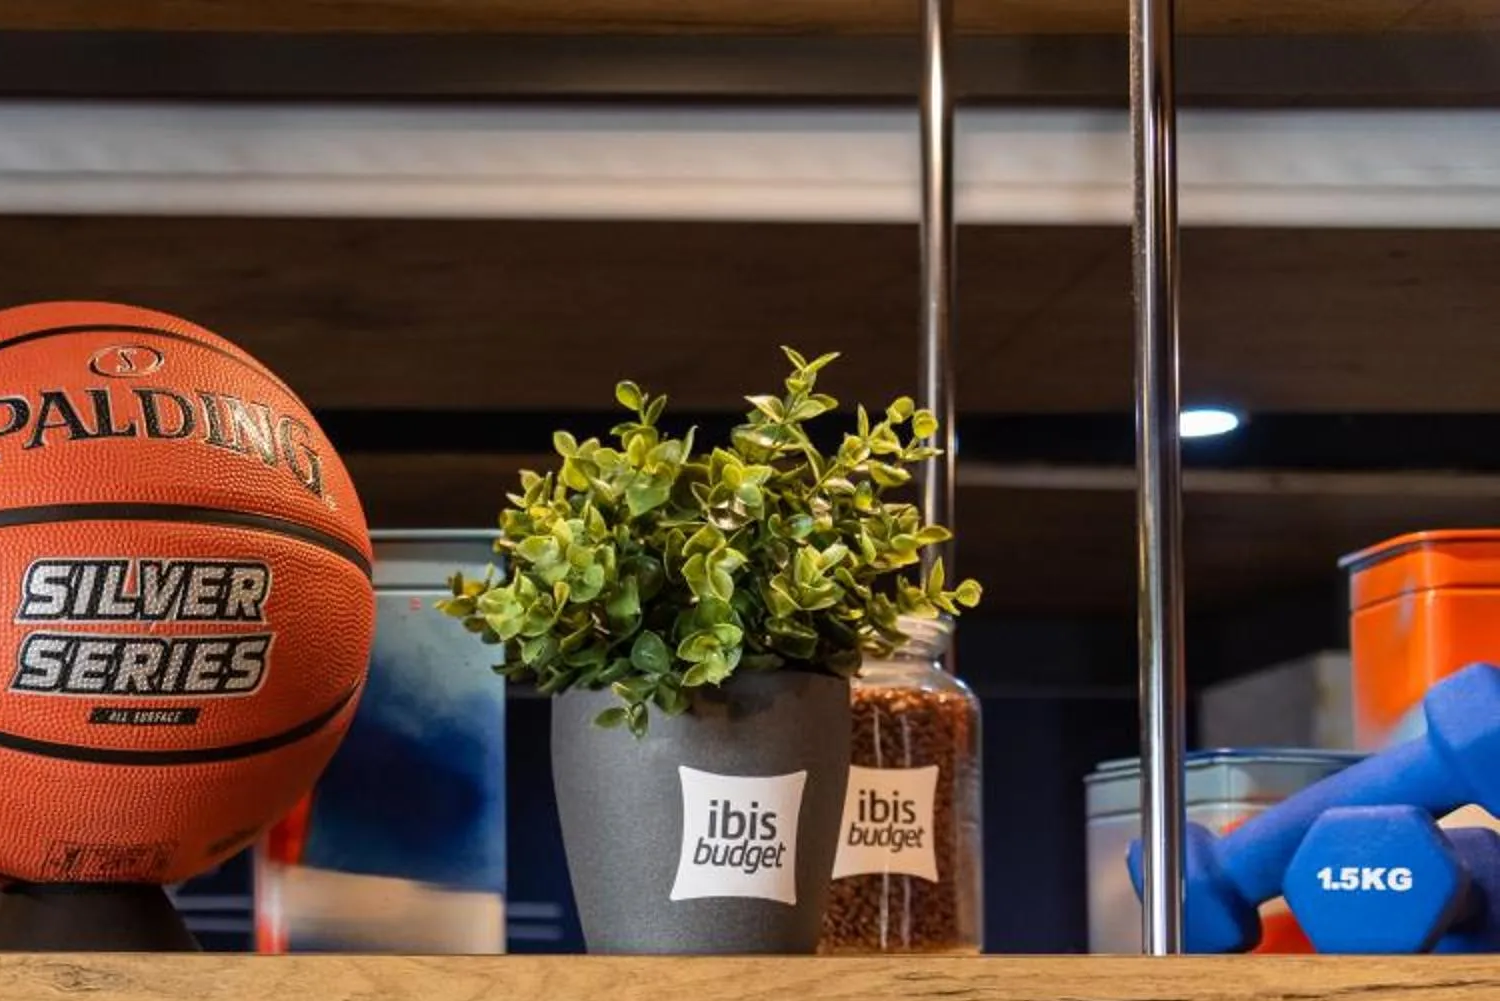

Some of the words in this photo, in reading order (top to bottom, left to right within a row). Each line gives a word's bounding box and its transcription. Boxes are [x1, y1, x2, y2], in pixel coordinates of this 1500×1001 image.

[15, 556, 273, 627] SILVER
[8, 631, 276, 699] SERIES
[108, 711, 128, 722] ALL
[133, 710, 182, 723] SURFACE
[708, 799, 777, 842] ibis
[856, 789, 916, 826] ibis
[847, 820, 926, 853] budget
[693, 836, 787, 876] budget
[1316, 867, 1413, 892] 1.5KG
